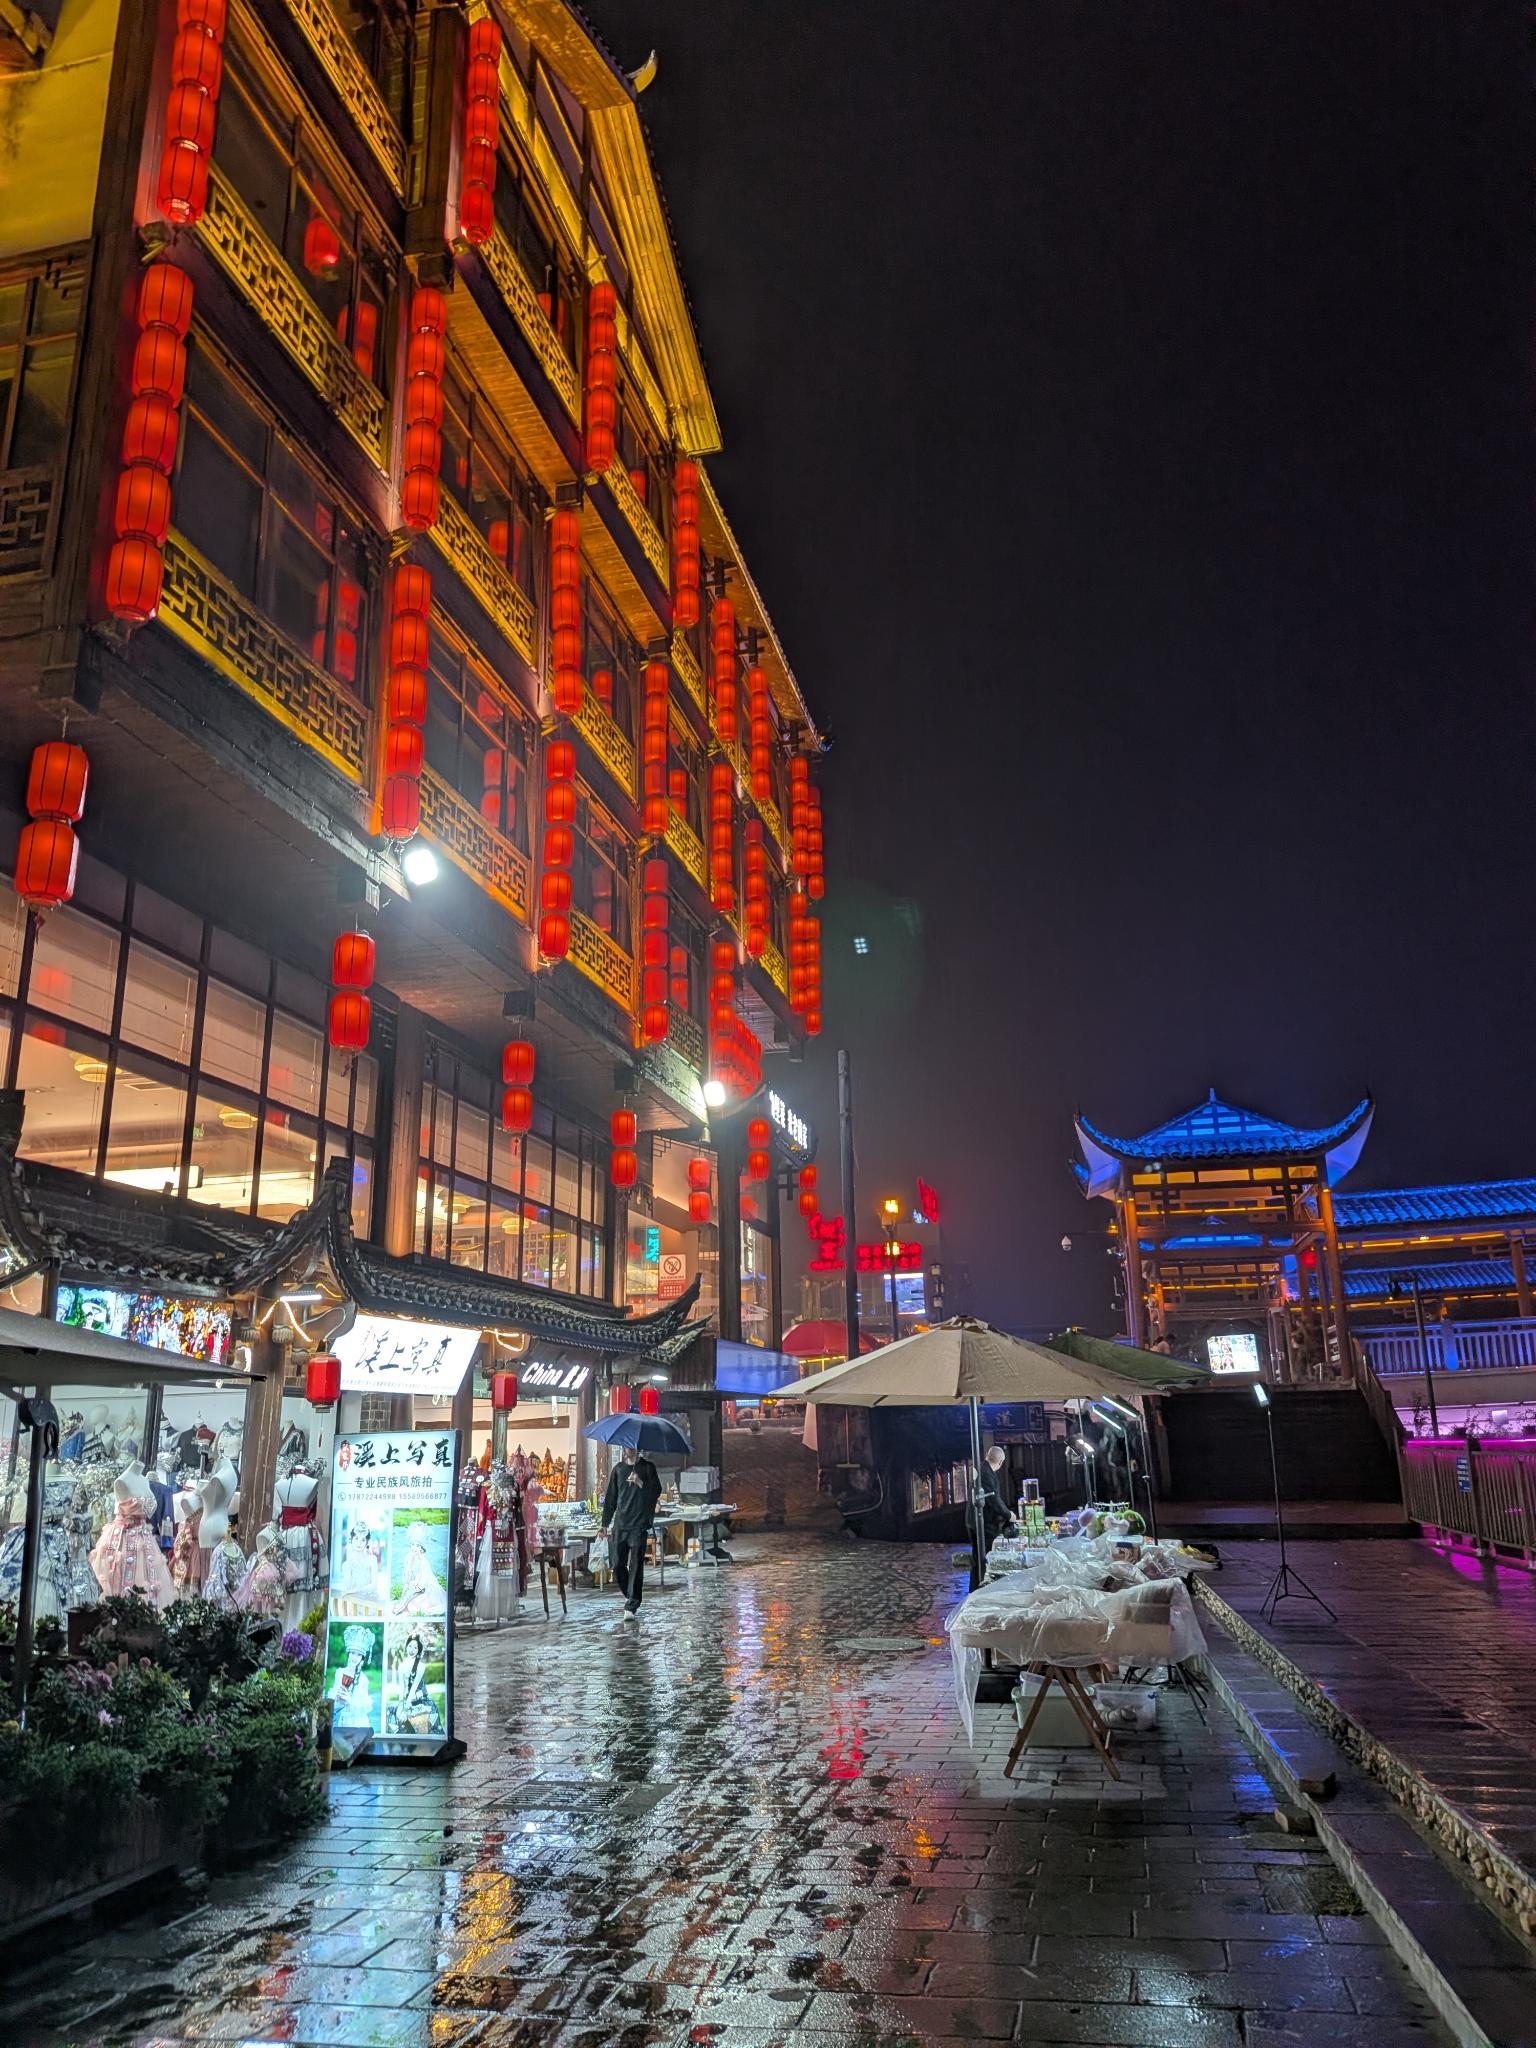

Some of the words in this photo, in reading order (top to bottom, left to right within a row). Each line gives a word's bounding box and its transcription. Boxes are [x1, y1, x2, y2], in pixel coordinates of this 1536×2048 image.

[521, 1362, 564, 1386] China
[353, 1438, 452, 1468] 溪上写真
[354, 1475, 432, 1489] 专业民族风旅拍
